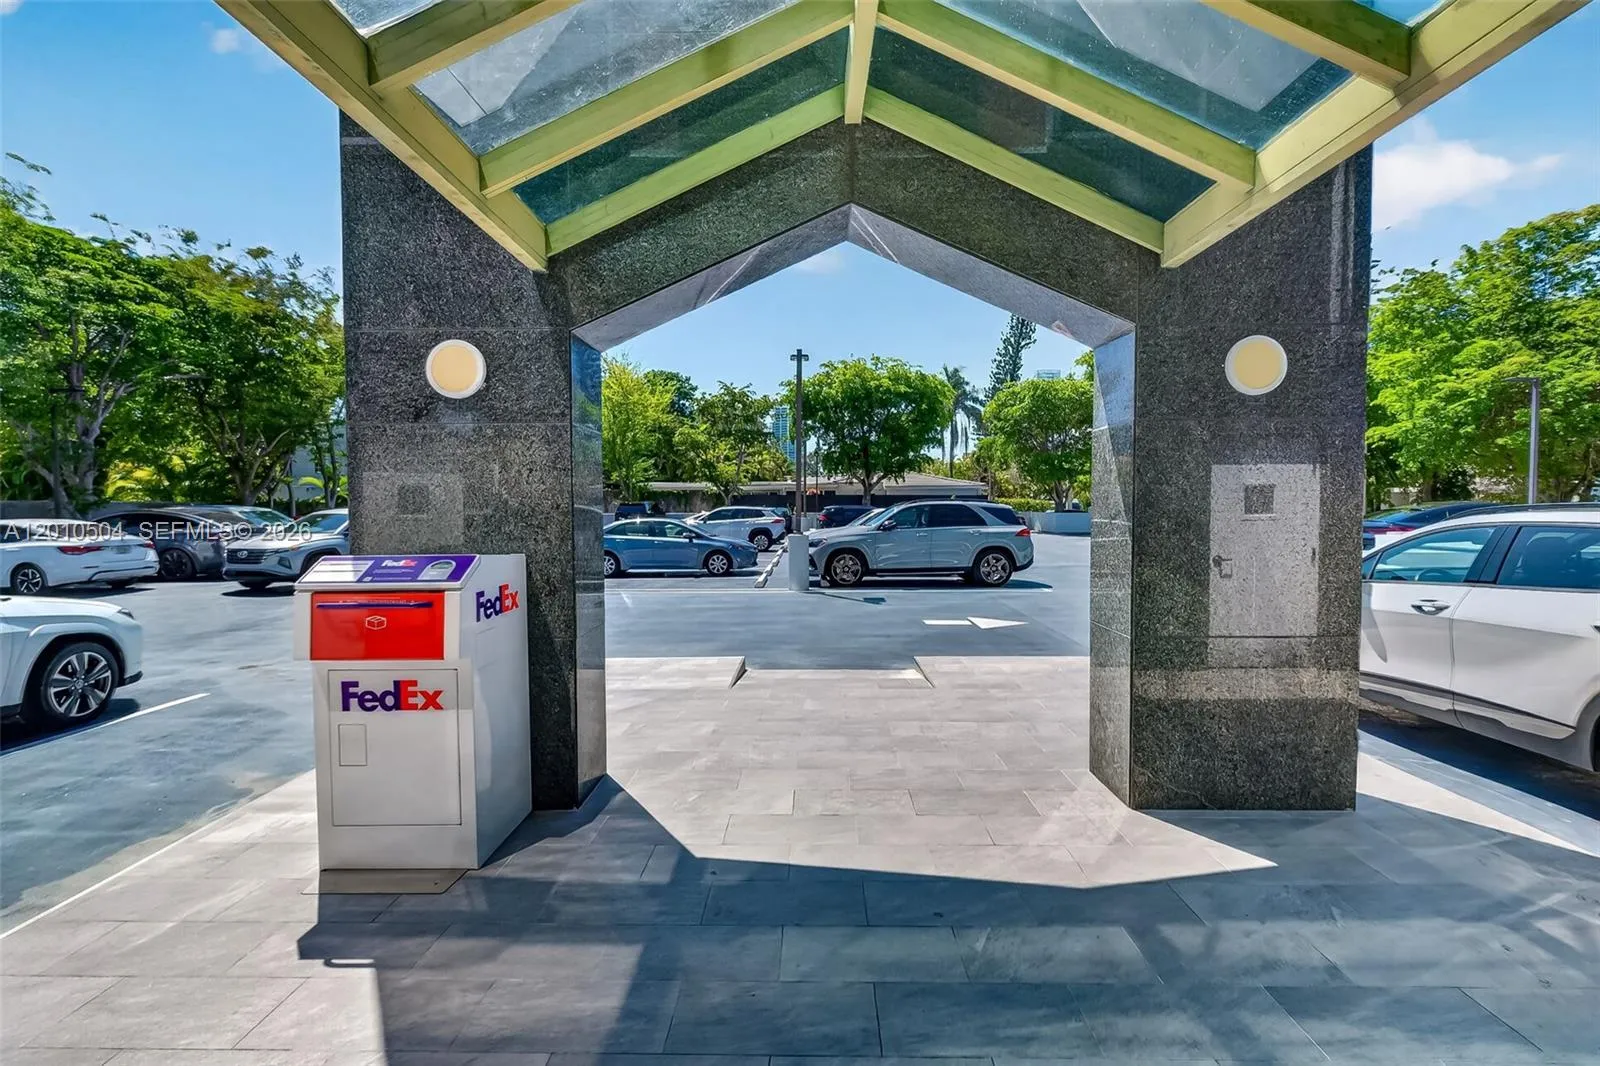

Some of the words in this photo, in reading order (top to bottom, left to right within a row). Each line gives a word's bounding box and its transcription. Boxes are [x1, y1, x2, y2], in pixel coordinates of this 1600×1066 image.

[380, 558, 418, 568] FedEx
[475, 583, 520, 623] FedEx
[340, 679, 444, 712] FedEx
